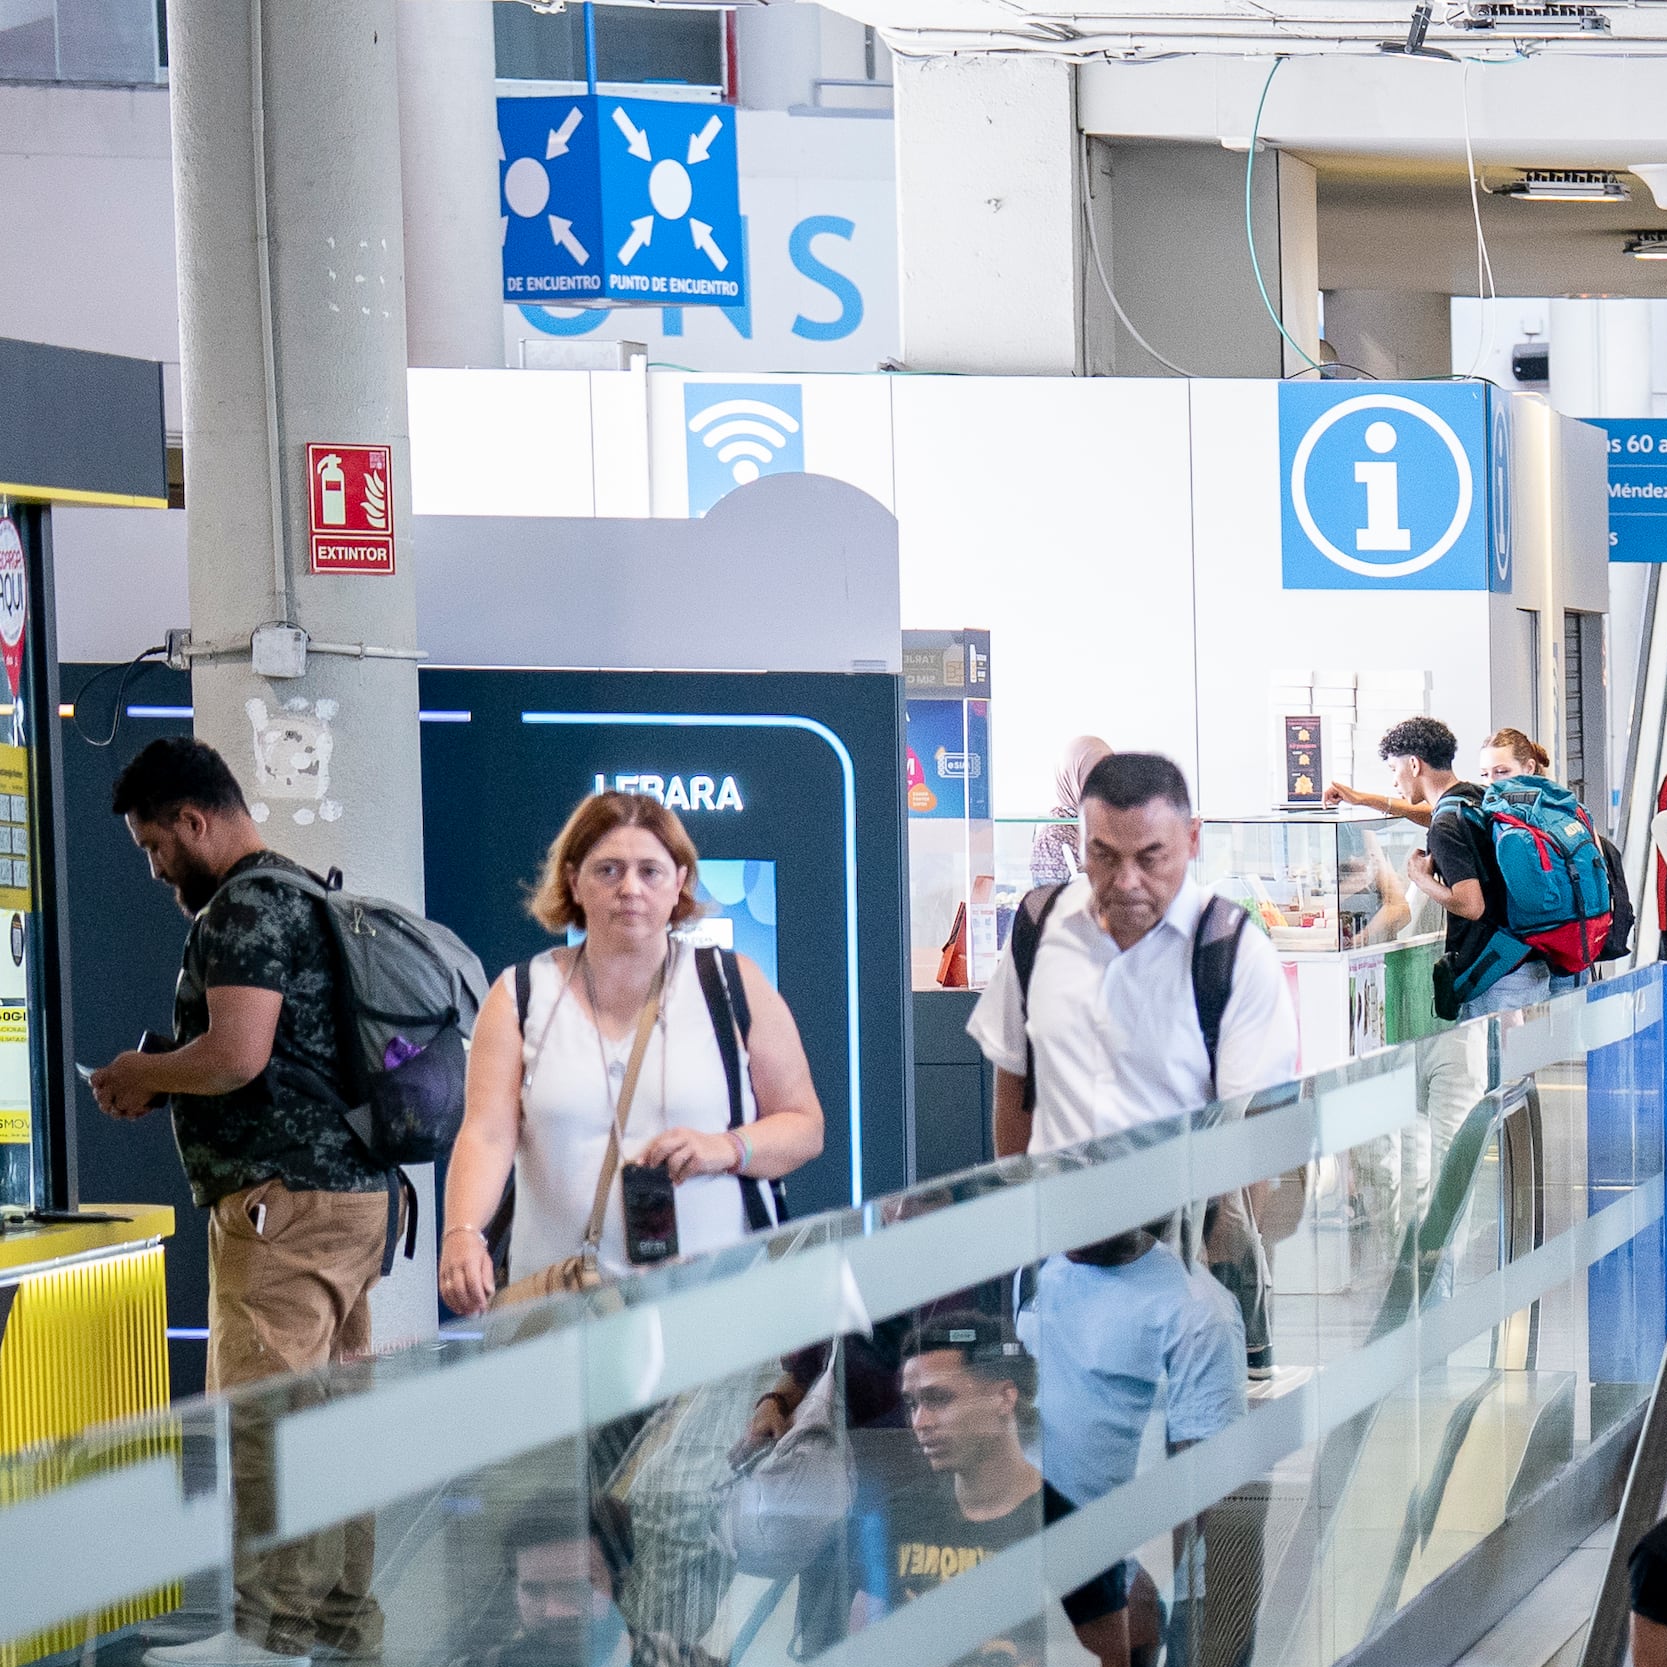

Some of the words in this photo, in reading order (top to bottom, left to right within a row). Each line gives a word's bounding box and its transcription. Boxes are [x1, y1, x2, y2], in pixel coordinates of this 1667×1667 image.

[507, 277, 524, 291] DE
[527, 275, 601, 291] ENCUENTRO
[610, 274, 650, 291] PUNTO
[652, 277, 668, 292] DE
[670, 278, 739, 296] ENCUENTRO
[1626, 435, 1654, 454] 60
[318, 545, 387, 561] EXTINTOR
